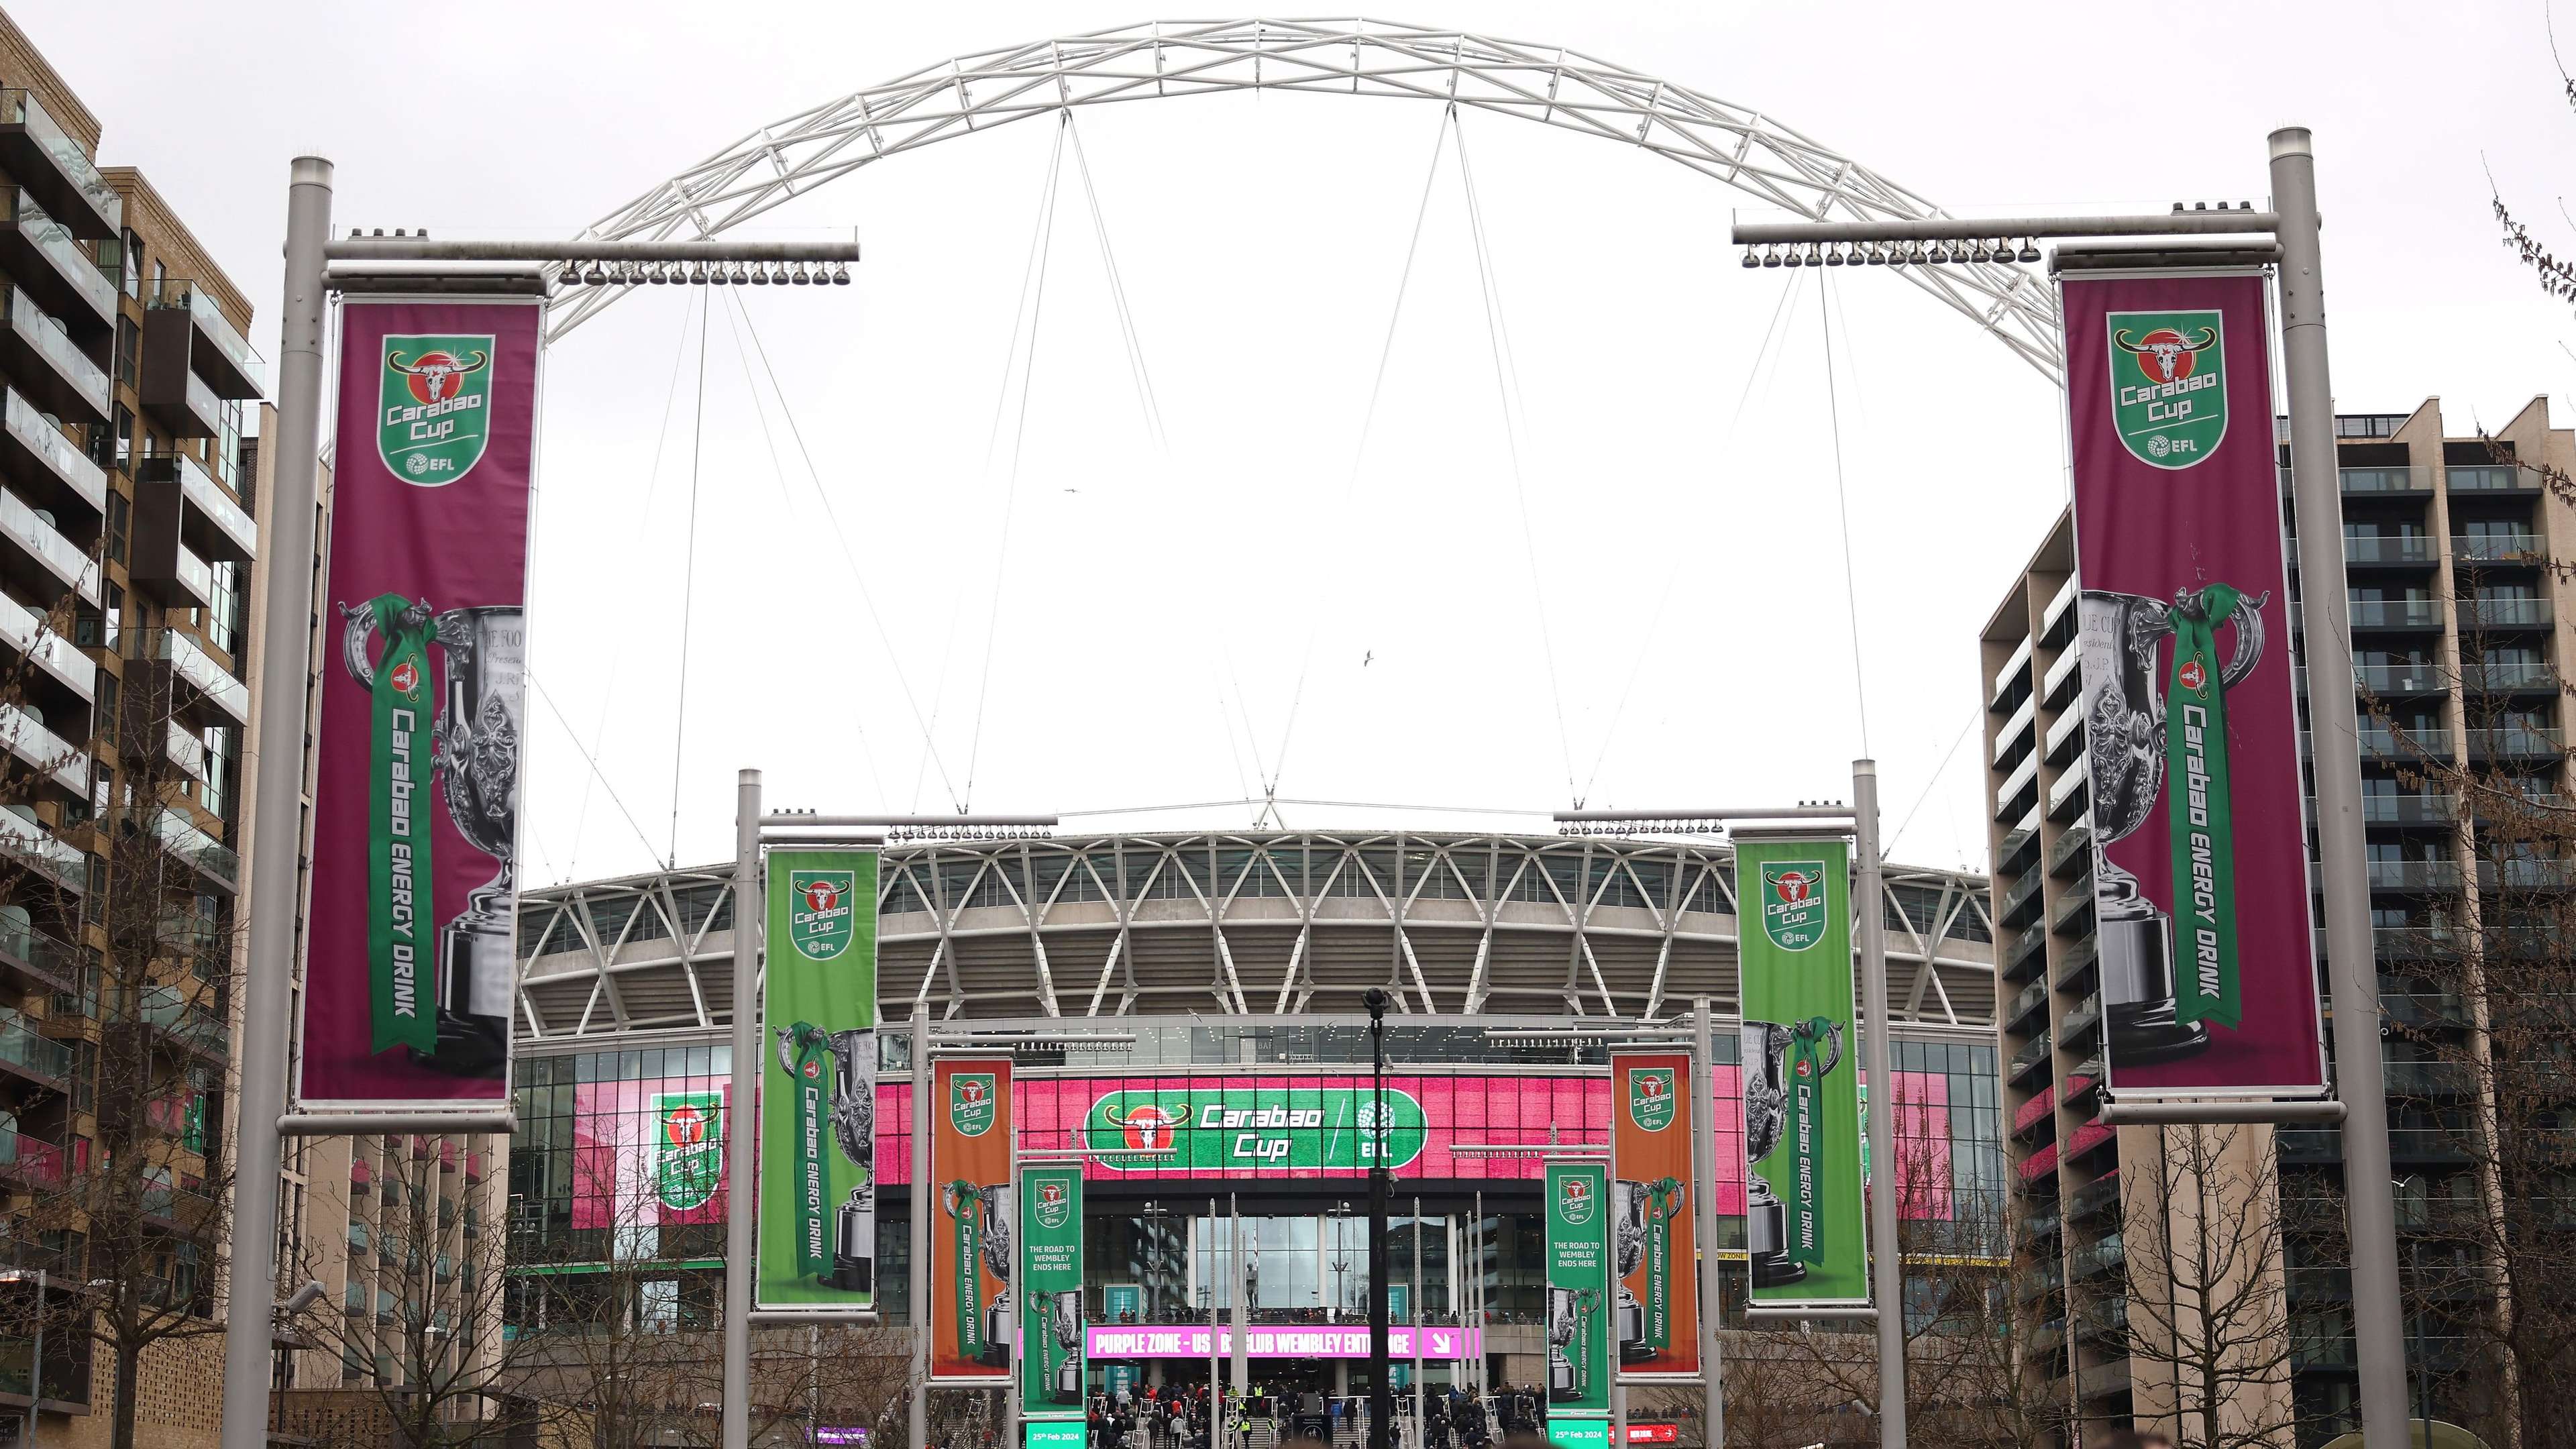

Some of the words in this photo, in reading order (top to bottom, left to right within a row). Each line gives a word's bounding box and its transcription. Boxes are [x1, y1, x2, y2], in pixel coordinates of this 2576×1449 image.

[2121, 372, 2216, 407] Carabao
[386, 394, 481, 426] Carabao
[2148, 399, 2192, 422] Cup
[410, 419, 454, 440] Cup
[2171, 439, 2197, 452] EFL
[429, 459, 454, 470] EFL
[391, 708, 416, 837] Carabao
[2183, 704, 2210, 827] Carabao
[391, 843, 413, 938] ENERGY
[2190, 833, 2216, 924] ENERGY
[795, 906, 848, 924] Carabao
[1767, 896, 1821, 915] Carabao
[1782, 912, 1807, 924] Cup
[809, 921, 833, 933] Cup
[2196, 928, 2220, 1000] DRINK
[393, 944, 415, 1018] DRINK
[954, 1098, 991, 1111] Carabao
[964, 1109, 981, 1118] Cup
[1633, 1093, 1671, 1106] Carabao
[1644, 1104, 1661, 1113] Cup
[805, 1087, 820, 1159] Carabao
[1199, 1104, 1326, 1130] Carabao
[1798, 1084, 1812, 1154] Carabao
[656, 1138, 717, 1163] Carabao
[1232, 1133, 1293, 1163] Cup
[807, 1162, 820, 1215] ENERGY
[1799, 1157, 1811, 1208] ENERGY
[1037, 1198, 1067, 1209] Carabao
[1562, 1194, 1591, 1205] Carabao
[808, 1218, 822, 1259] DRINK
[1801, 1210, 1813, 1250] DRINK
[963, 1225, 973, 1275] Carabao
[1654, 1224, 1663, 1273] Carabao
[964, 1277, 974, 1314] ENERGY
[1654, 1274, 1662, 1309] ENERGY
[966, 1316, 975, 1345] DRINK
[1654, 1311, 1663, 1339] DRINK
[1095, 1334, 1144, 1354] PURPLE
[1147, 1333, 1181, 1353] ZONE
[1276, 1333, 1342, 1353] WEMBLEY
[1555, 1431, 1570, 1439] 25th
